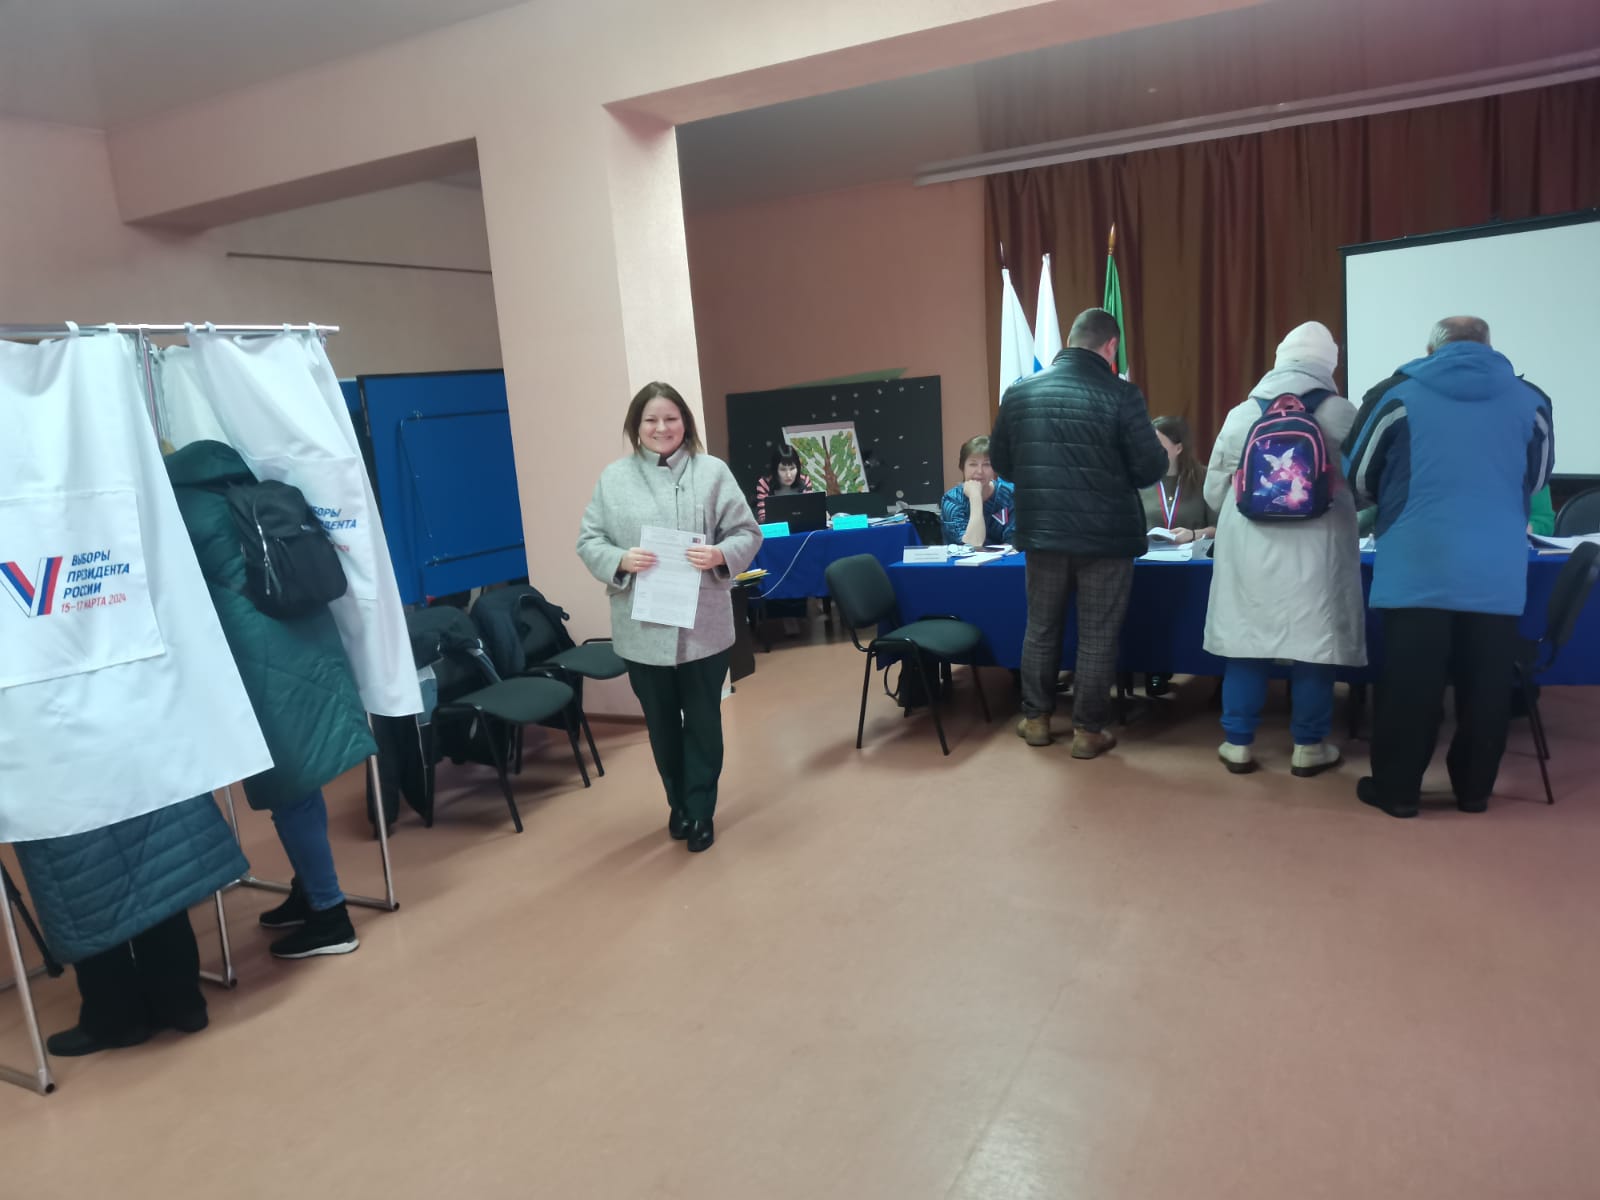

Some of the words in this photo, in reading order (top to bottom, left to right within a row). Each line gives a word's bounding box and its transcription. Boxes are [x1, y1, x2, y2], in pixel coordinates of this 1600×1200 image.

[66, 563, 130, 583] ПРЗИДЕНТА
[63, 582, 102, 600] РОССИИ
[108, 592, 127, 605] 2024
